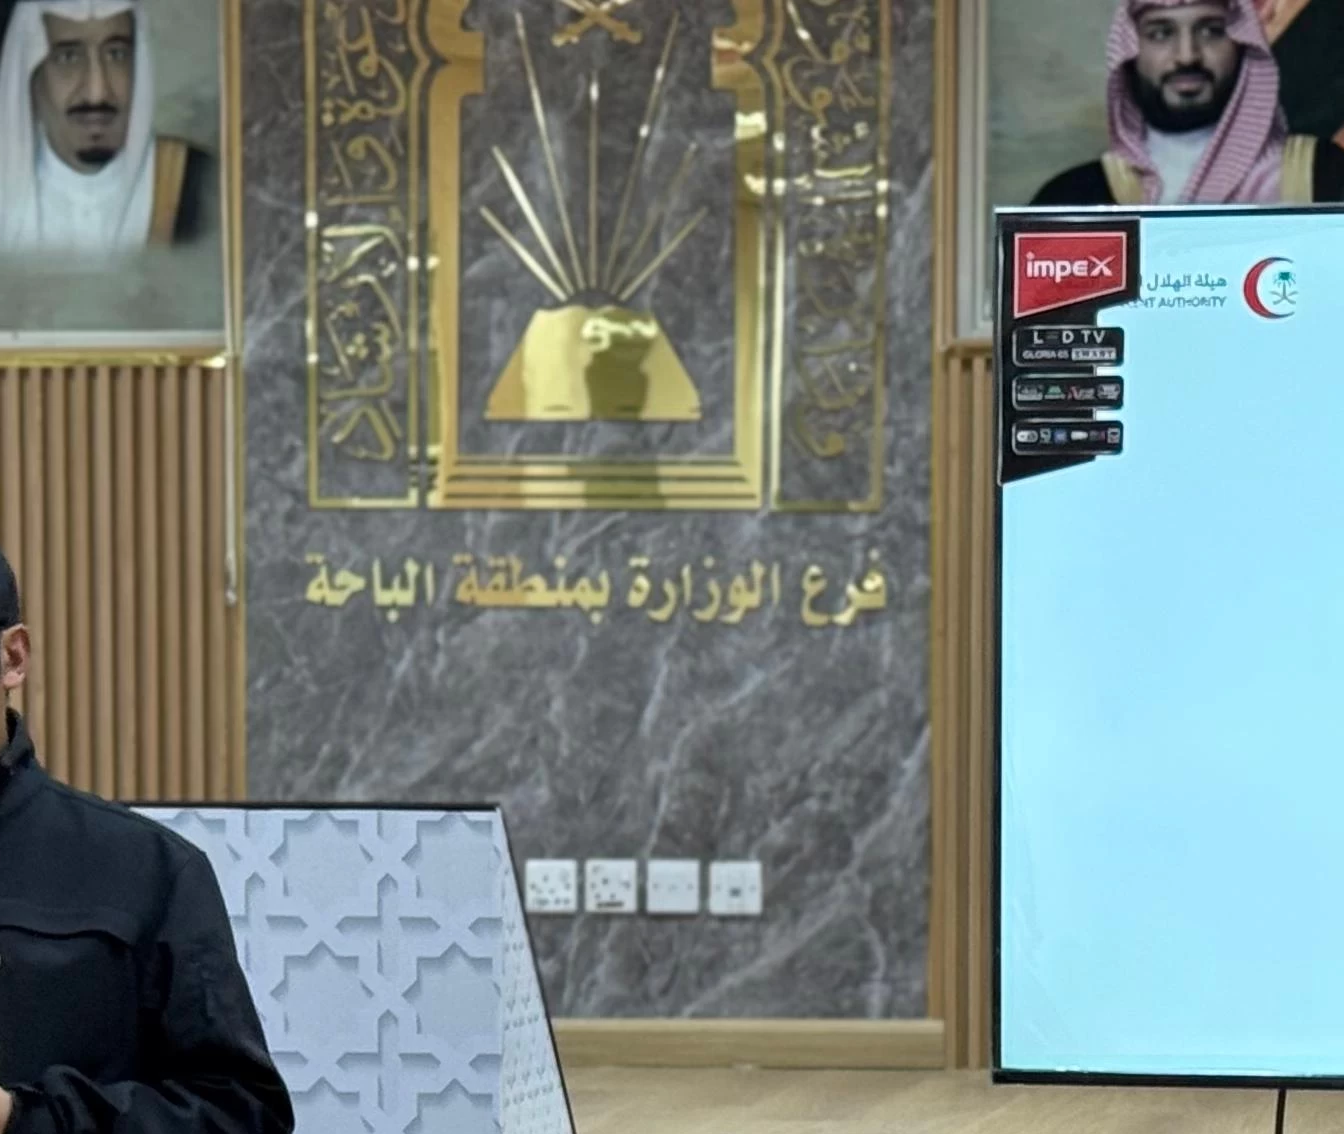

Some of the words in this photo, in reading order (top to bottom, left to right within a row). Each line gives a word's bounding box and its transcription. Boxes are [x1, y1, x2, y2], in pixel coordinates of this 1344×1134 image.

[1158, 295, 1227, 309] AUTHORITY
[1080, 329, 1107, 345] TV
[304, 553, 434, 623] الباحة
[452, 554, 611, 626] بمنطقة
[627, 556, 781, 624] الوزارة
[800, 548, 888, 627] فرع
